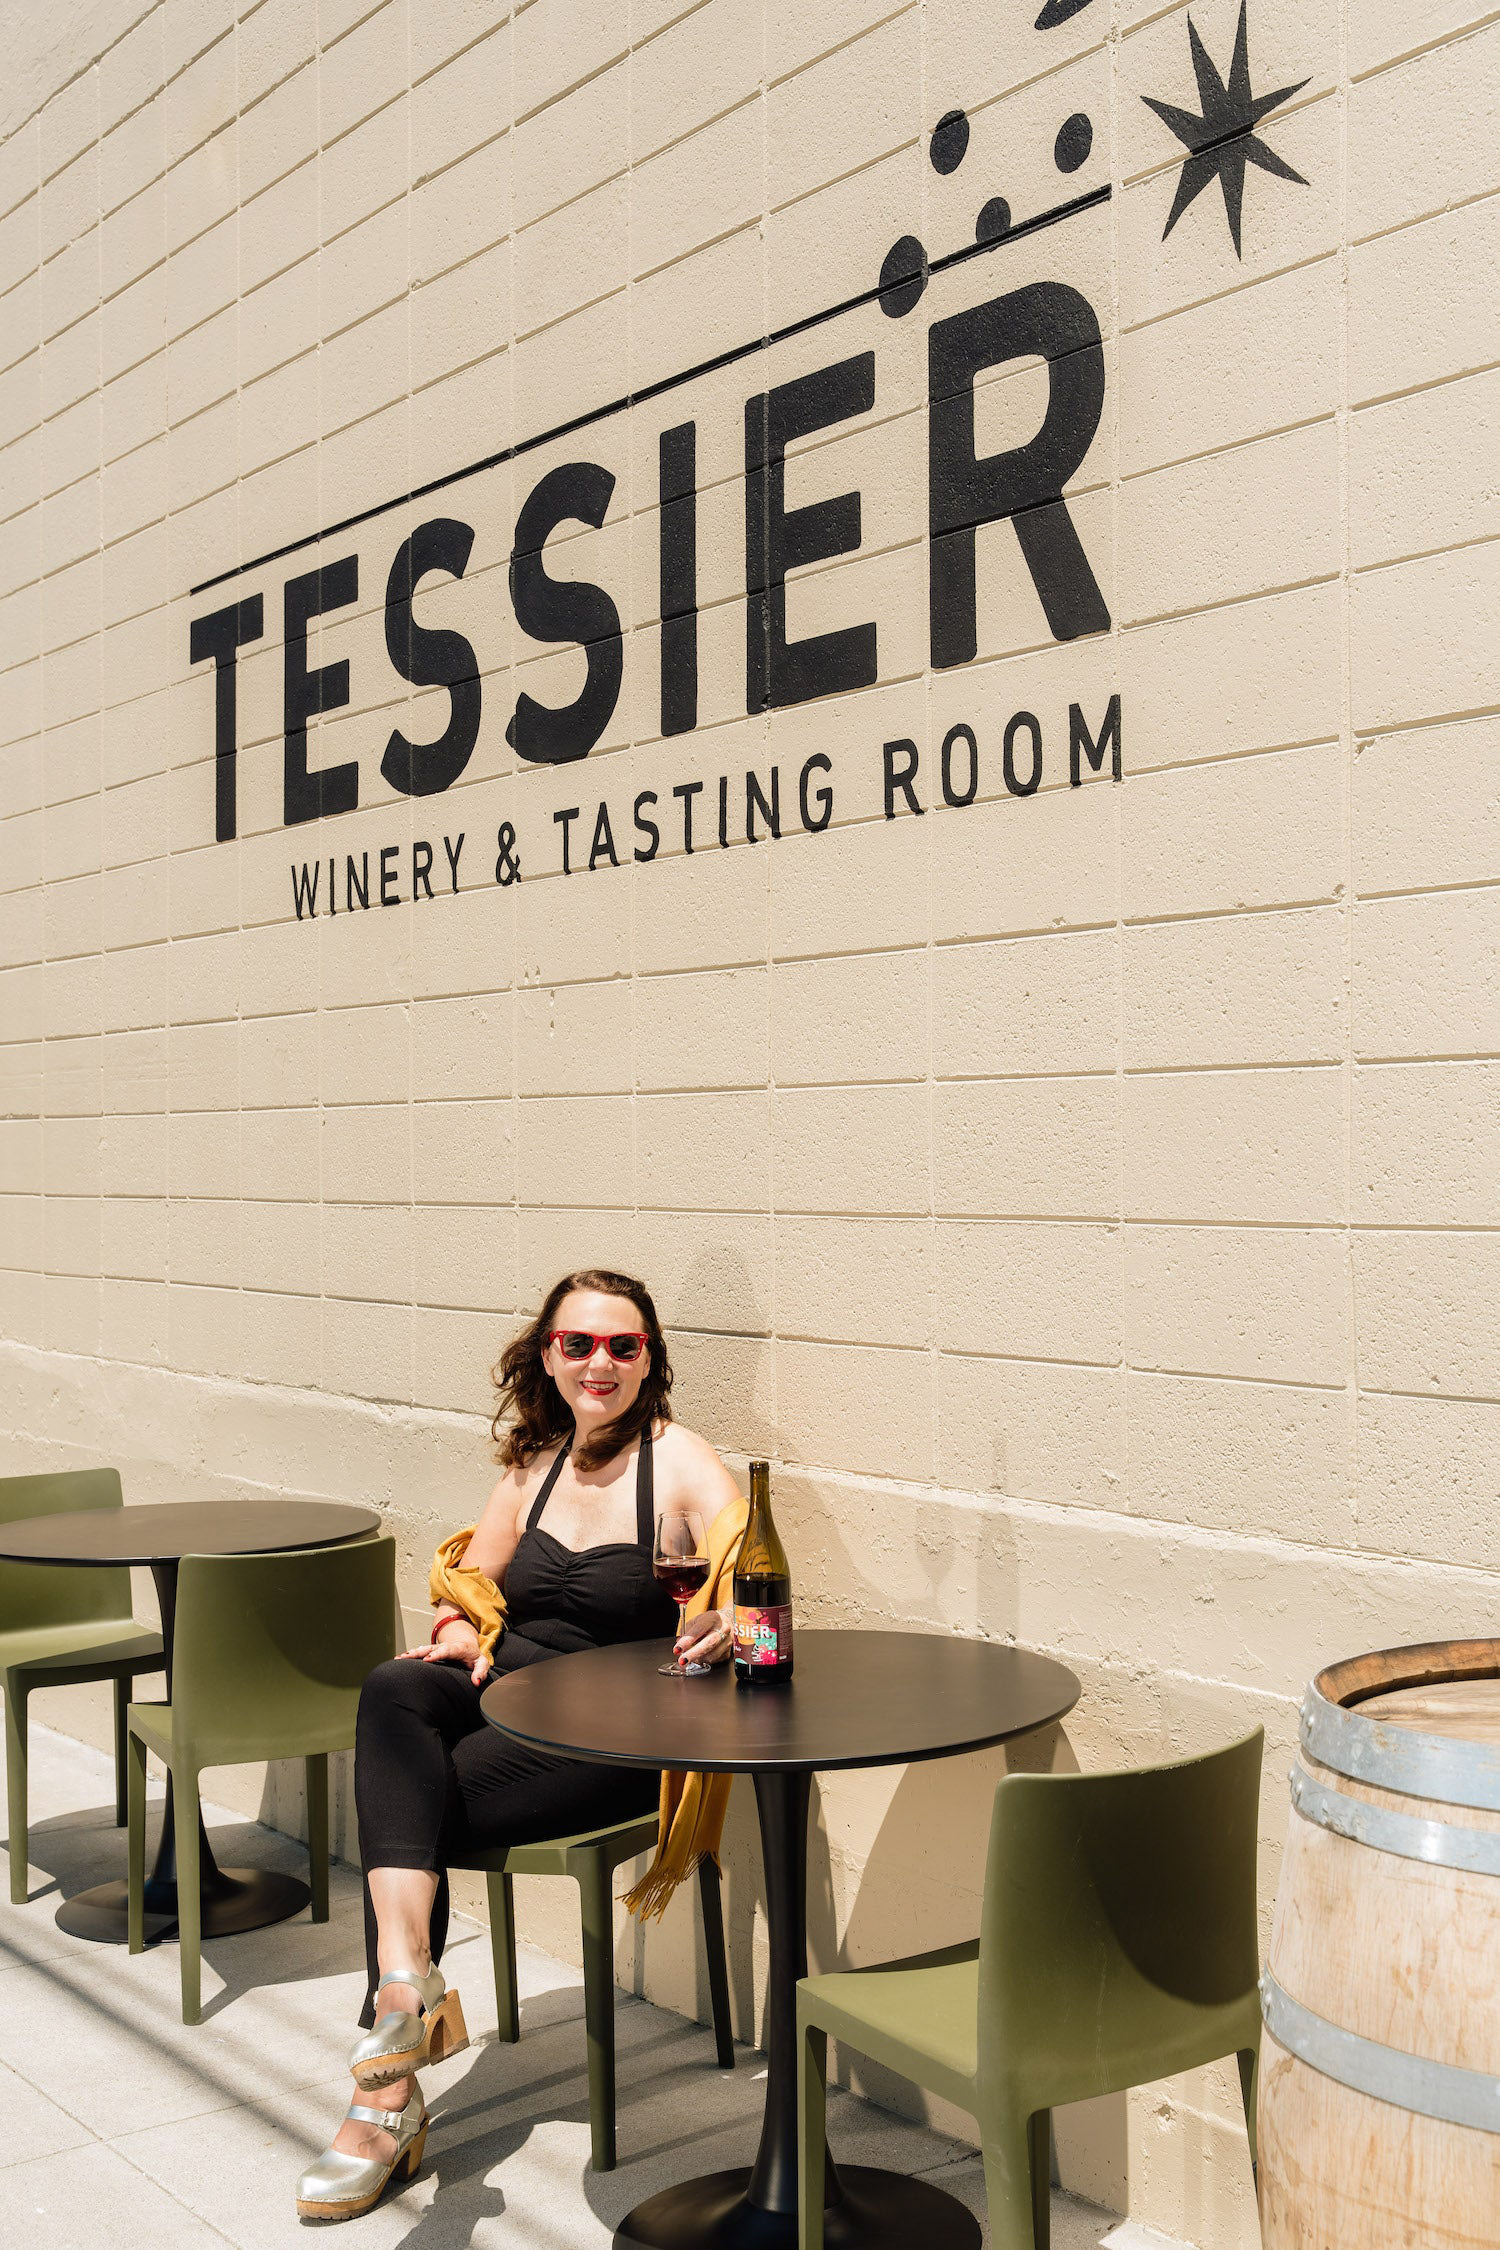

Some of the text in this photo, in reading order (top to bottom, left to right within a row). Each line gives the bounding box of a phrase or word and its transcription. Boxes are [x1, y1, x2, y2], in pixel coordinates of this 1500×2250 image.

[190, 281, 1112, 843] TESSIER
[291, 693, 1122, 921] WINERY & TASTING ROOM
